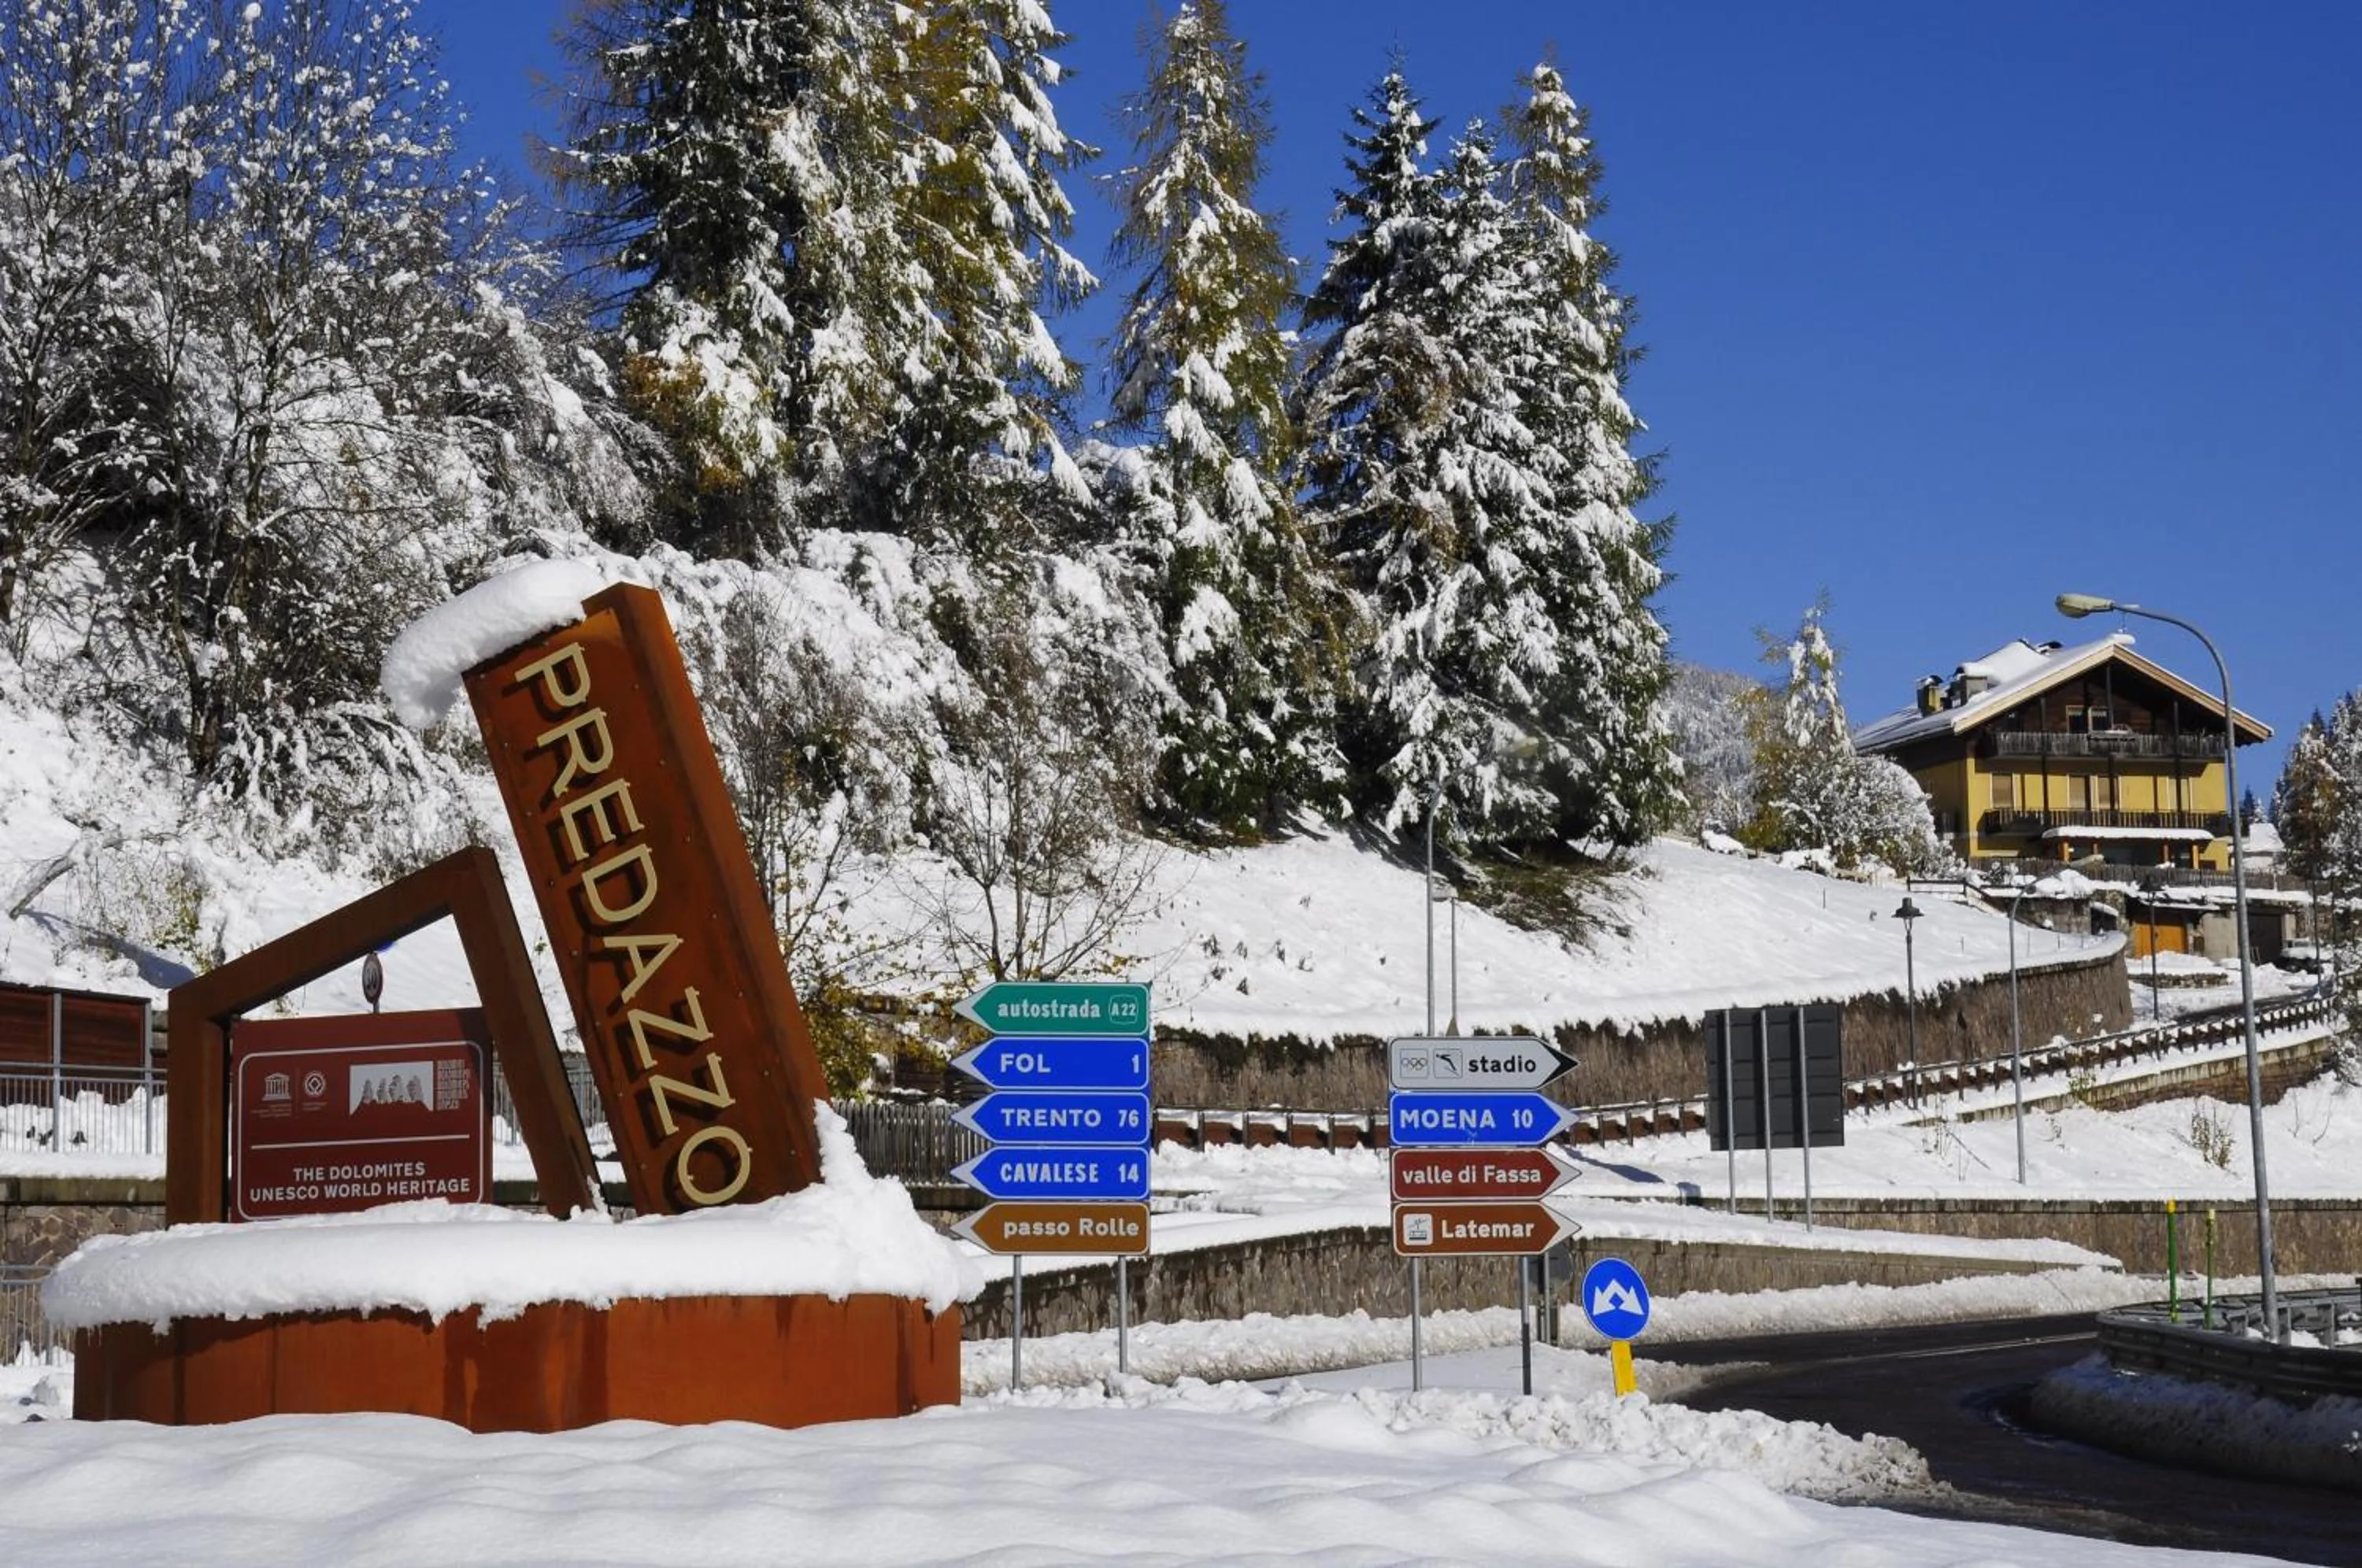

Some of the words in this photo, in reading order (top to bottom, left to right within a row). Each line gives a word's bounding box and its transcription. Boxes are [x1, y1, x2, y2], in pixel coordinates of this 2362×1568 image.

[515, 641, 752, 1205] PREDAZZO
[998, 1000, 1101, 1018] autostrada
[1111, 1002, 1136, 1016] A22
[1000, 1053, 1051, 1074] FOL
[1131, 1054, 1140, 1074] 1
[1468, 1056, 1537, 1073] stadio
[1001, 1108, 1101, 1127] TRENTO
[1118, 1109, 1139, 1127] 76
[1400, 1109, 1496, 1129] MOENA
[1512, 1109, 1533, 1129] 10
[293, 1167, 325, 1182] THE
[329, 1161, 426, 1180] DOLOMITES
[1000, 1163, 1100, 1183] CAVALESE
[1118, 1163, 1139, 1183] 14
[1402, 1165, 1453, 1184] valle
[1458, 1165, 1476, 1183] di
[1483, 1165, 1542, 1183] Fassa
[250, 1185, 319, 1202] UNESCO
[324, 1181, 381, 1198] WORLD
[387, 1178, 471, 1196] HERITAGE
[1003, 1221, 1070, 1240] passo
[1079, 1218, 1139, 1236] Rolle
[1442, 1219, 1534, 1238] Latemar
